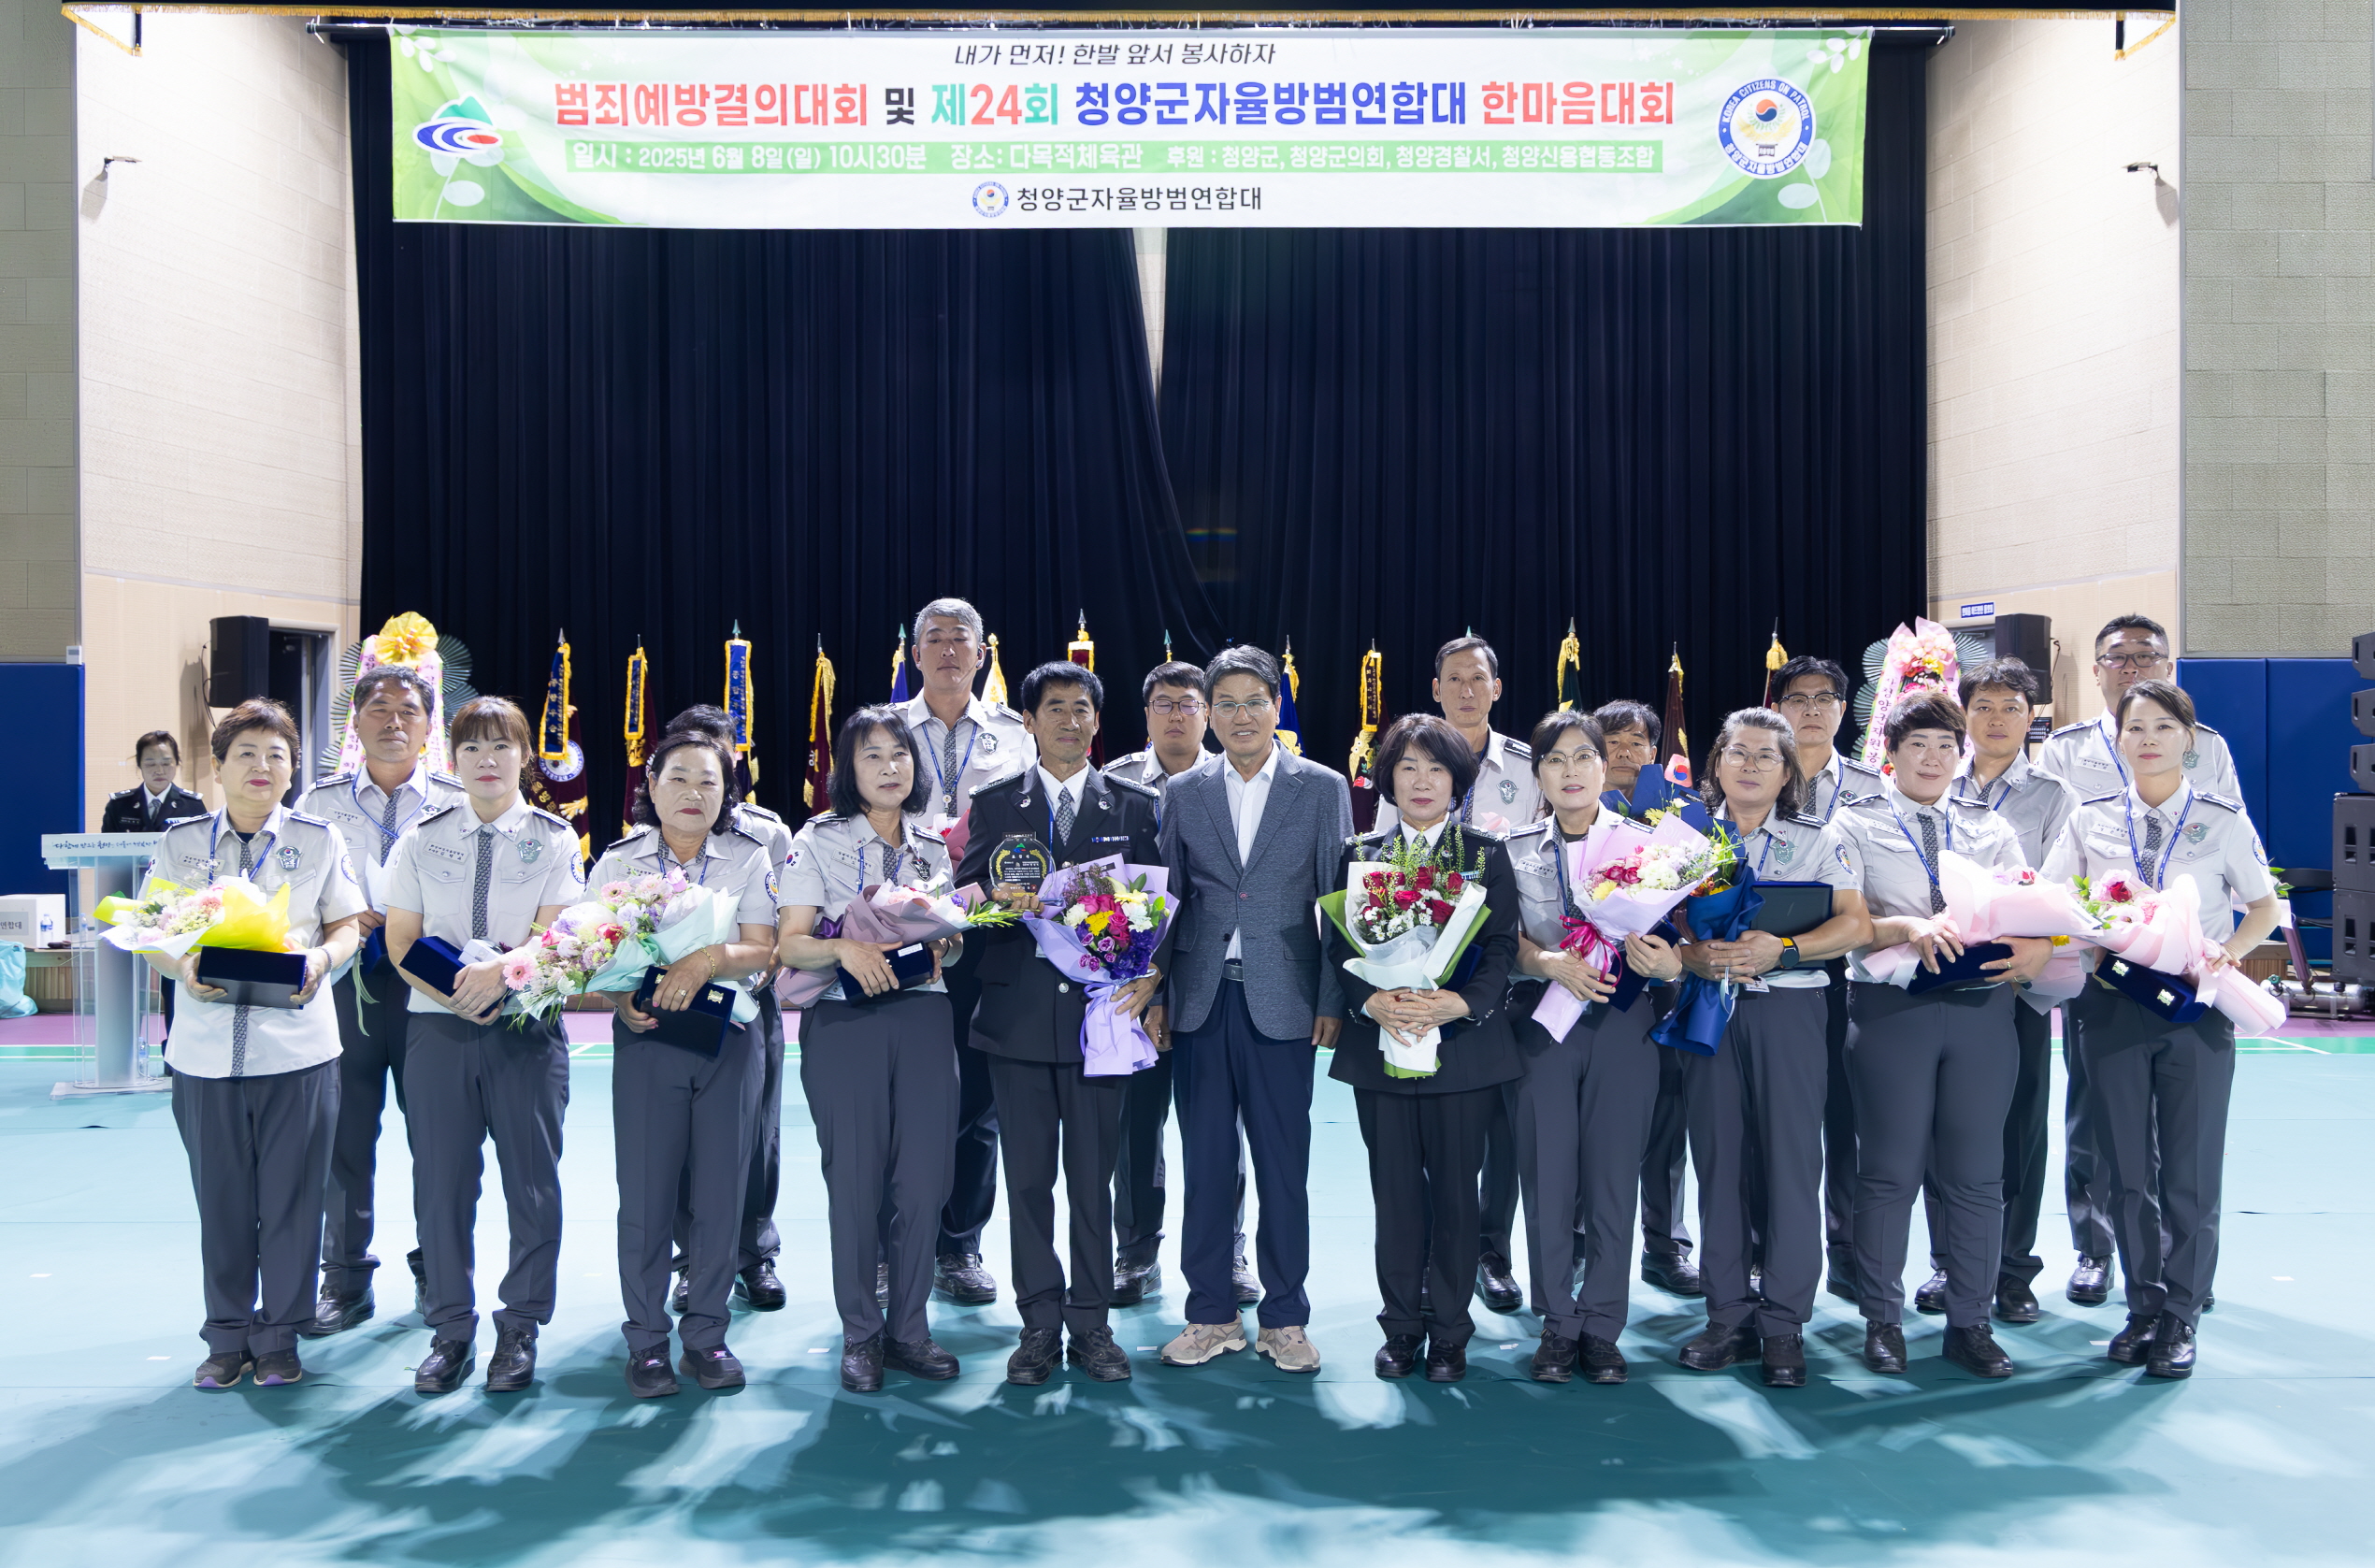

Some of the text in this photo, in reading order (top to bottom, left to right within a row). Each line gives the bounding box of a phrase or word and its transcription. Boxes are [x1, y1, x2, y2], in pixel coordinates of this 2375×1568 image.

[955, 43, 1276, 65] 내가 먼저! 한발 앞서 봉사하자
[554, 80, 1674, 126] 범죄예방결의대회 및 제24회 청양군자율방범연합대 한마음대회
[1722, 79, 1810, 123] KOREA CITIZENS ON PATROL
[573, 142, 617, 168] 일시
[639, 147, 706, 169] 2025년
[712, 145, 744, 169] 6월
[828, 144, 928, 169] 10시30분
[1010, 143, 1144, 169] 다목적체육관
[1166, 145, 1204, 168] 후원
[1221, 145, 1286, 170] 청양군,
[1289, 145, 1391, 170] 청양군의회,
[1396, 145, 1497, 170] 청양경찰서,
[1502, 145, 1655, 168] 청양신용협동조합
[1017, 185, 1262, 211] 청양군자율방범연합대
